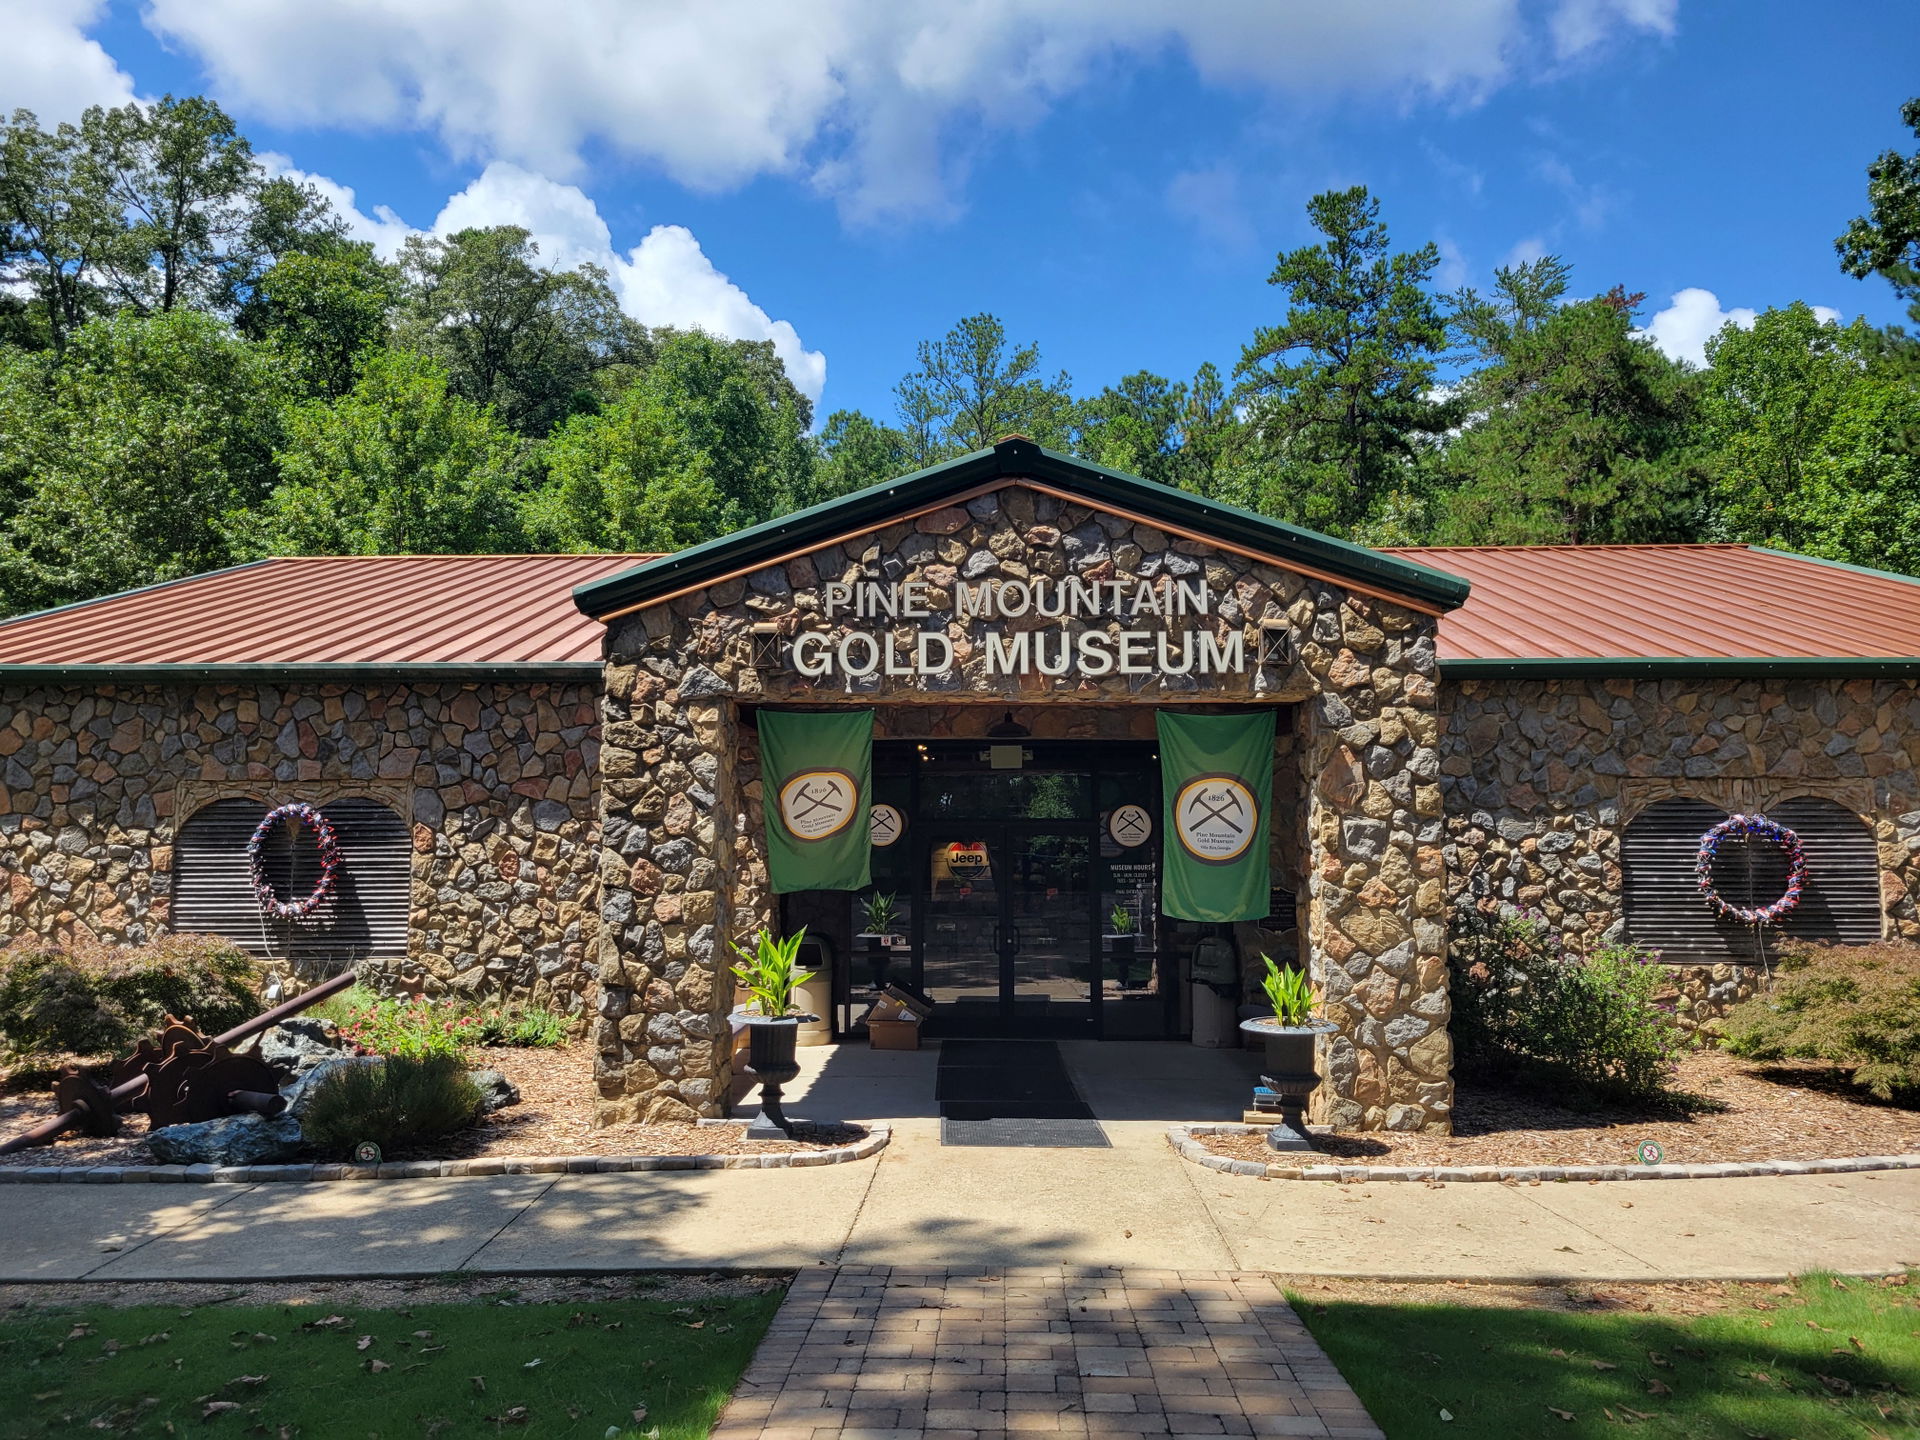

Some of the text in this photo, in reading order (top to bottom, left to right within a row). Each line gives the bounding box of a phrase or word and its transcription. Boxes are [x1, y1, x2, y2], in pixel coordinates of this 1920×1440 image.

[825, 578, 1209, 618] PINE MOUNTAIN
[792, 630, 1245, 678] GOLD MUSEUM
[1208, 794, 1225, 802] 1826
[951, 852, 983, 865] Jeep
